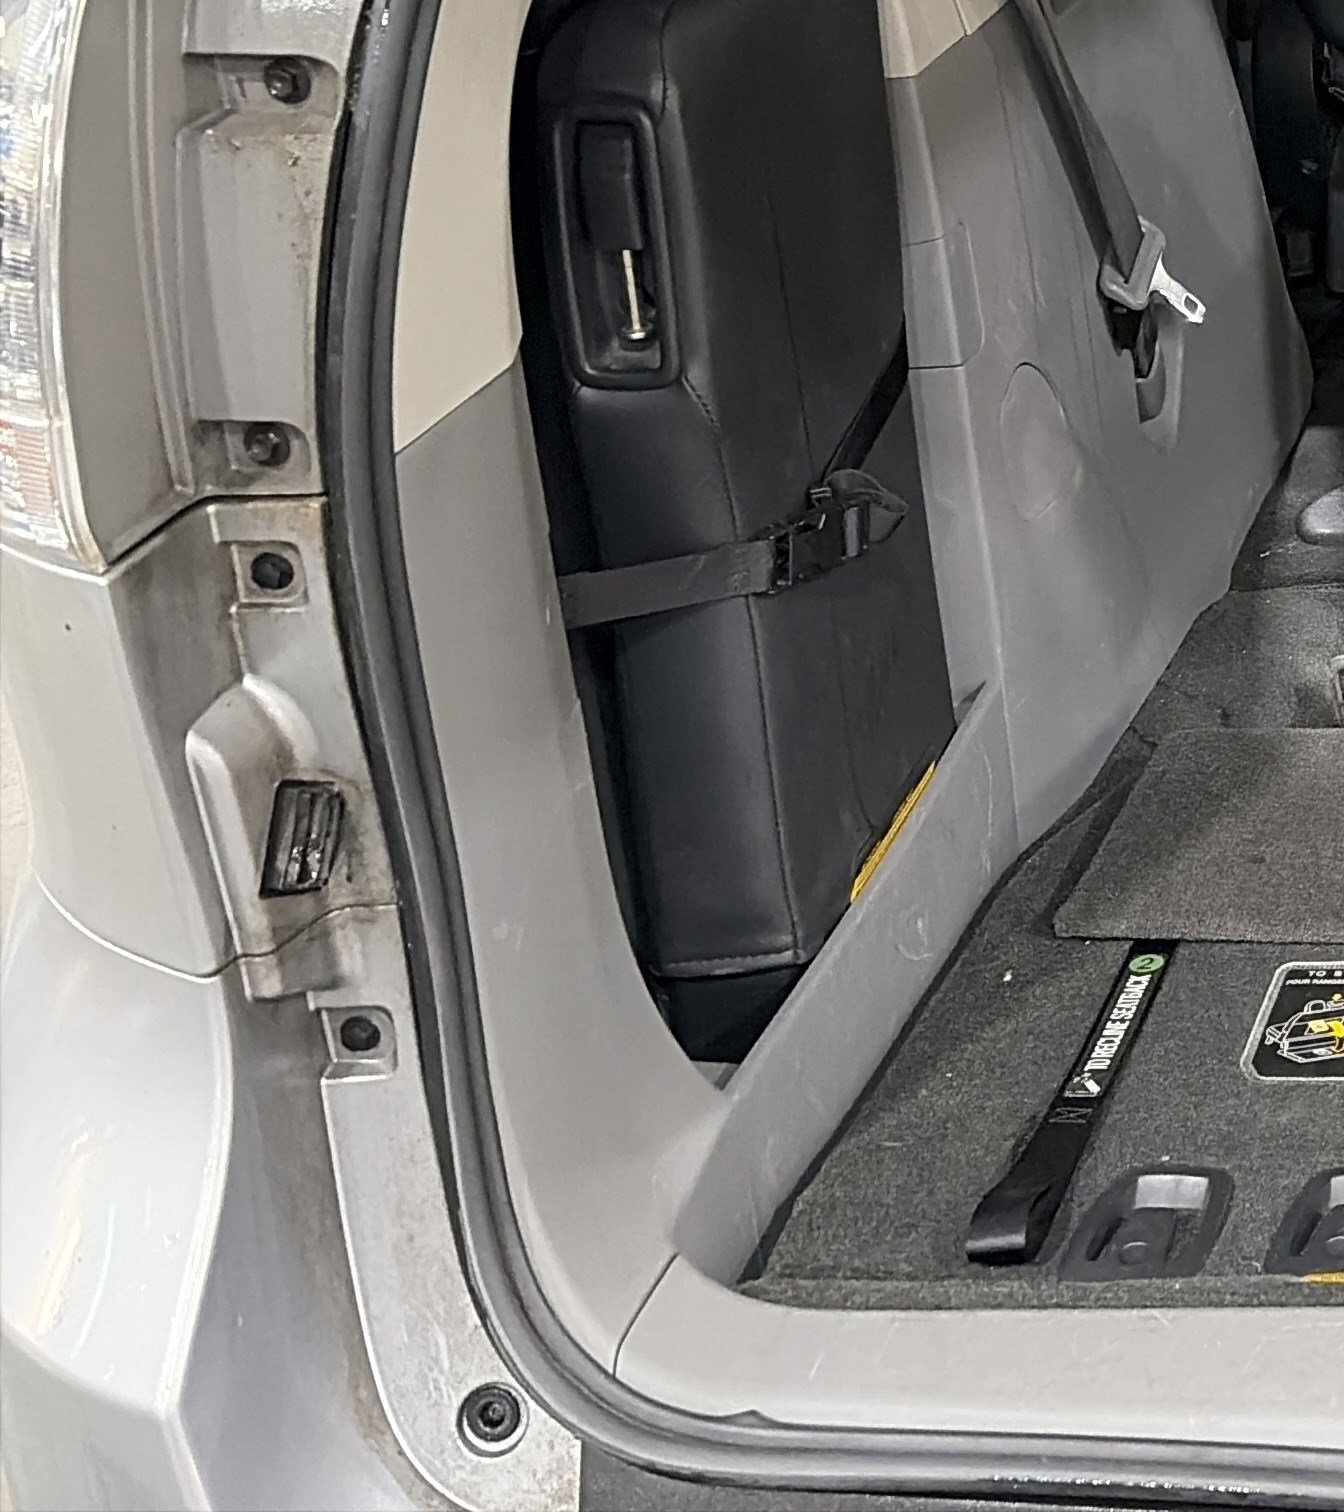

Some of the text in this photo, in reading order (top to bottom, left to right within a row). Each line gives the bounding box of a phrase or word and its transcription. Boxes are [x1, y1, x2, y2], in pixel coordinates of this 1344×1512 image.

[1109, 974, 1153, 1021] SEATBACK
[1285, 978, 1311, 986] POUR
[1090, 1020, 1131, 1059] RECLINE
